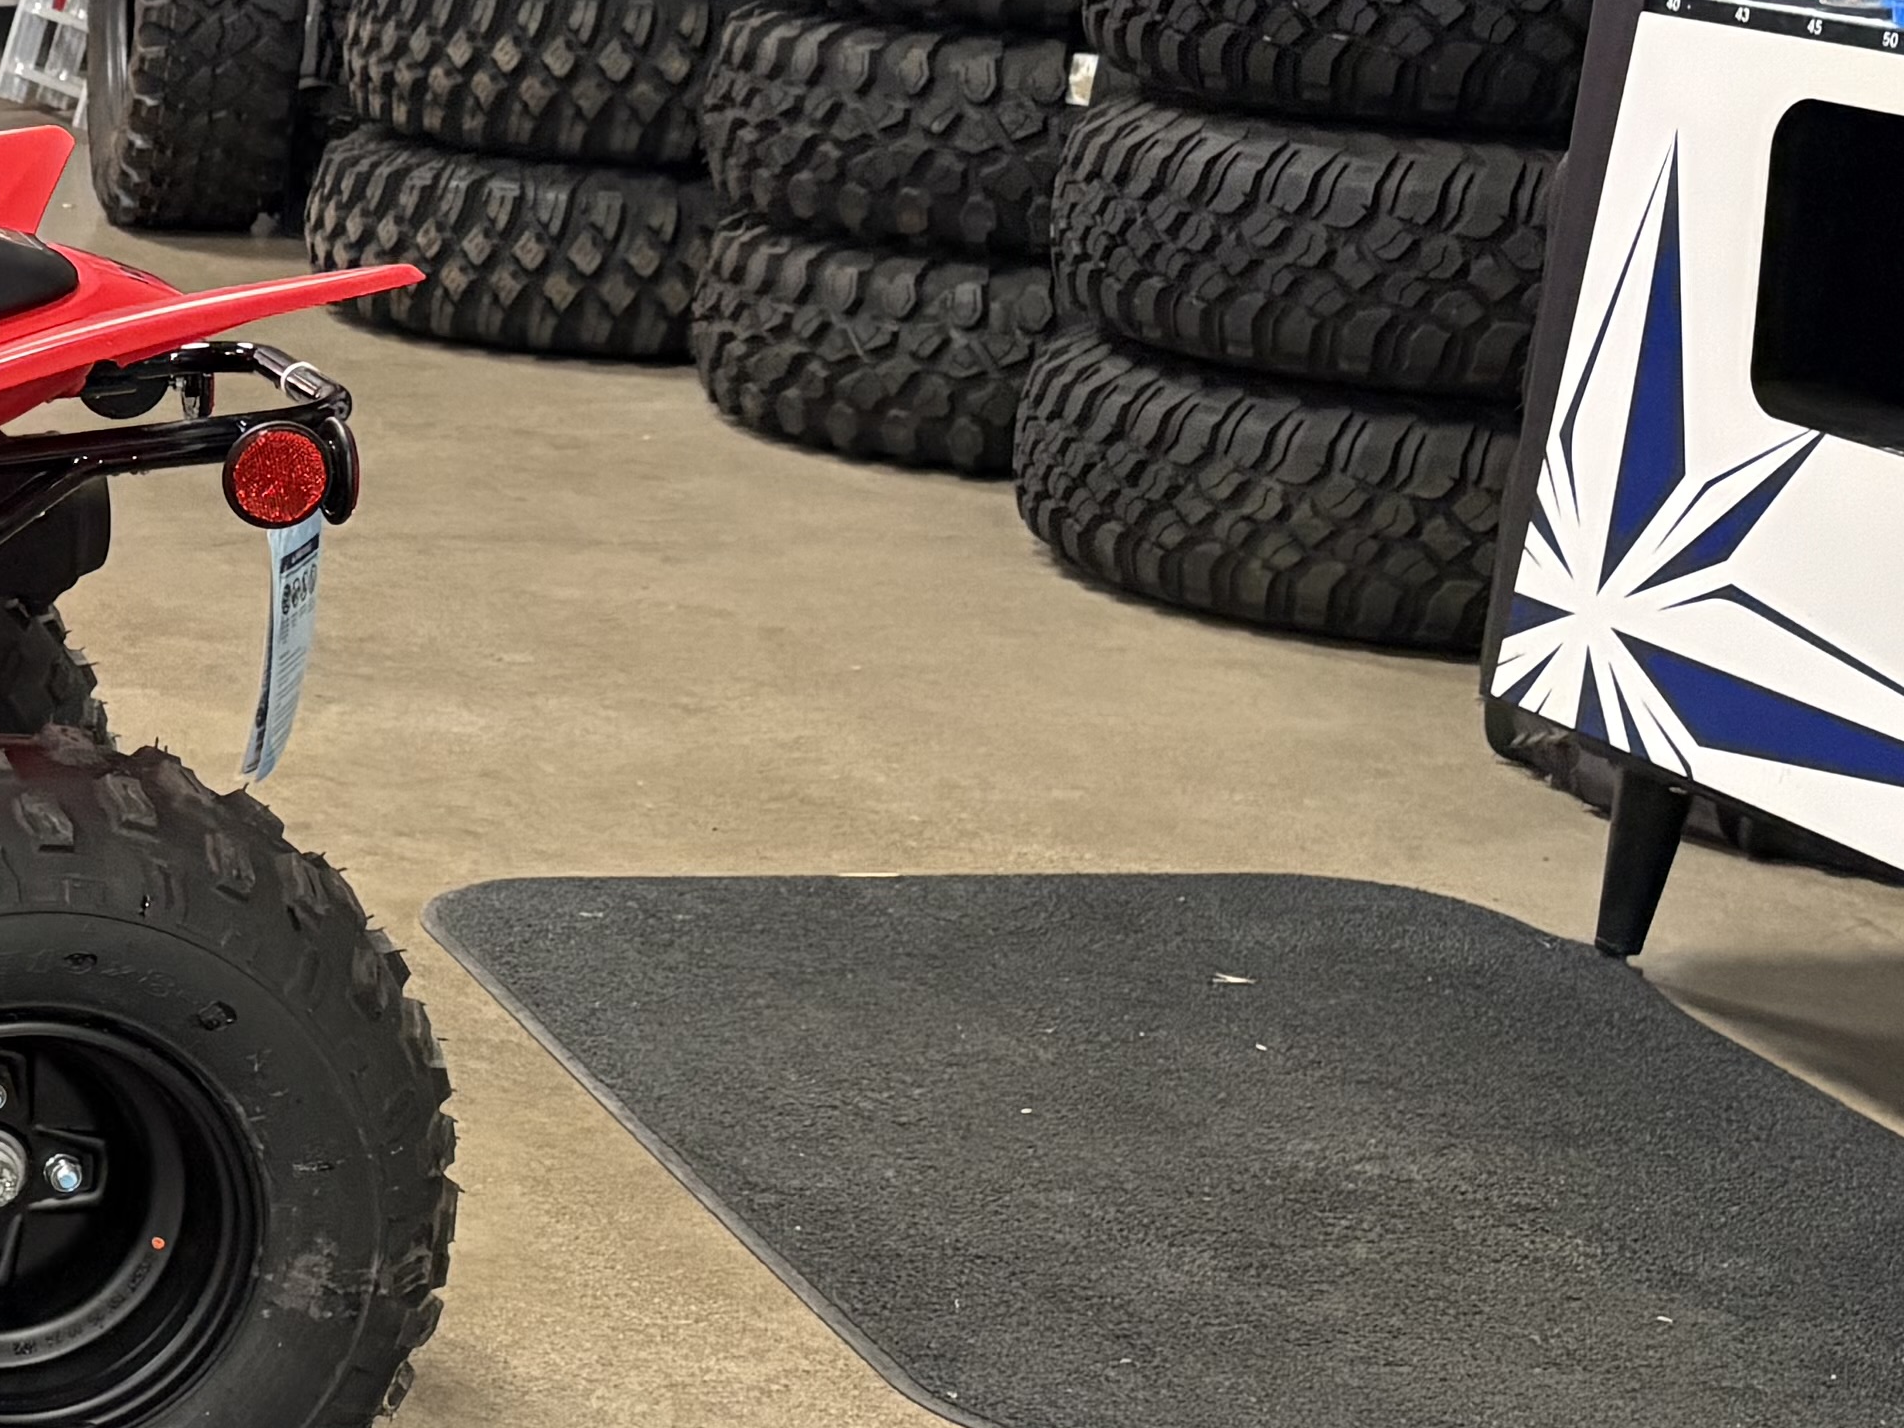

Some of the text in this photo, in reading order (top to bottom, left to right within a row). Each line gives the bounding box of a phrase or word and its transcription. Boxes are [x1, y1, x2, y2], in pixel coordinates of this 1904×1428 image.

[1735, 7, 1750, 23] 43
[1807, 18, 1823, 35] 45
[1882, 31, 1899, 48] 50
